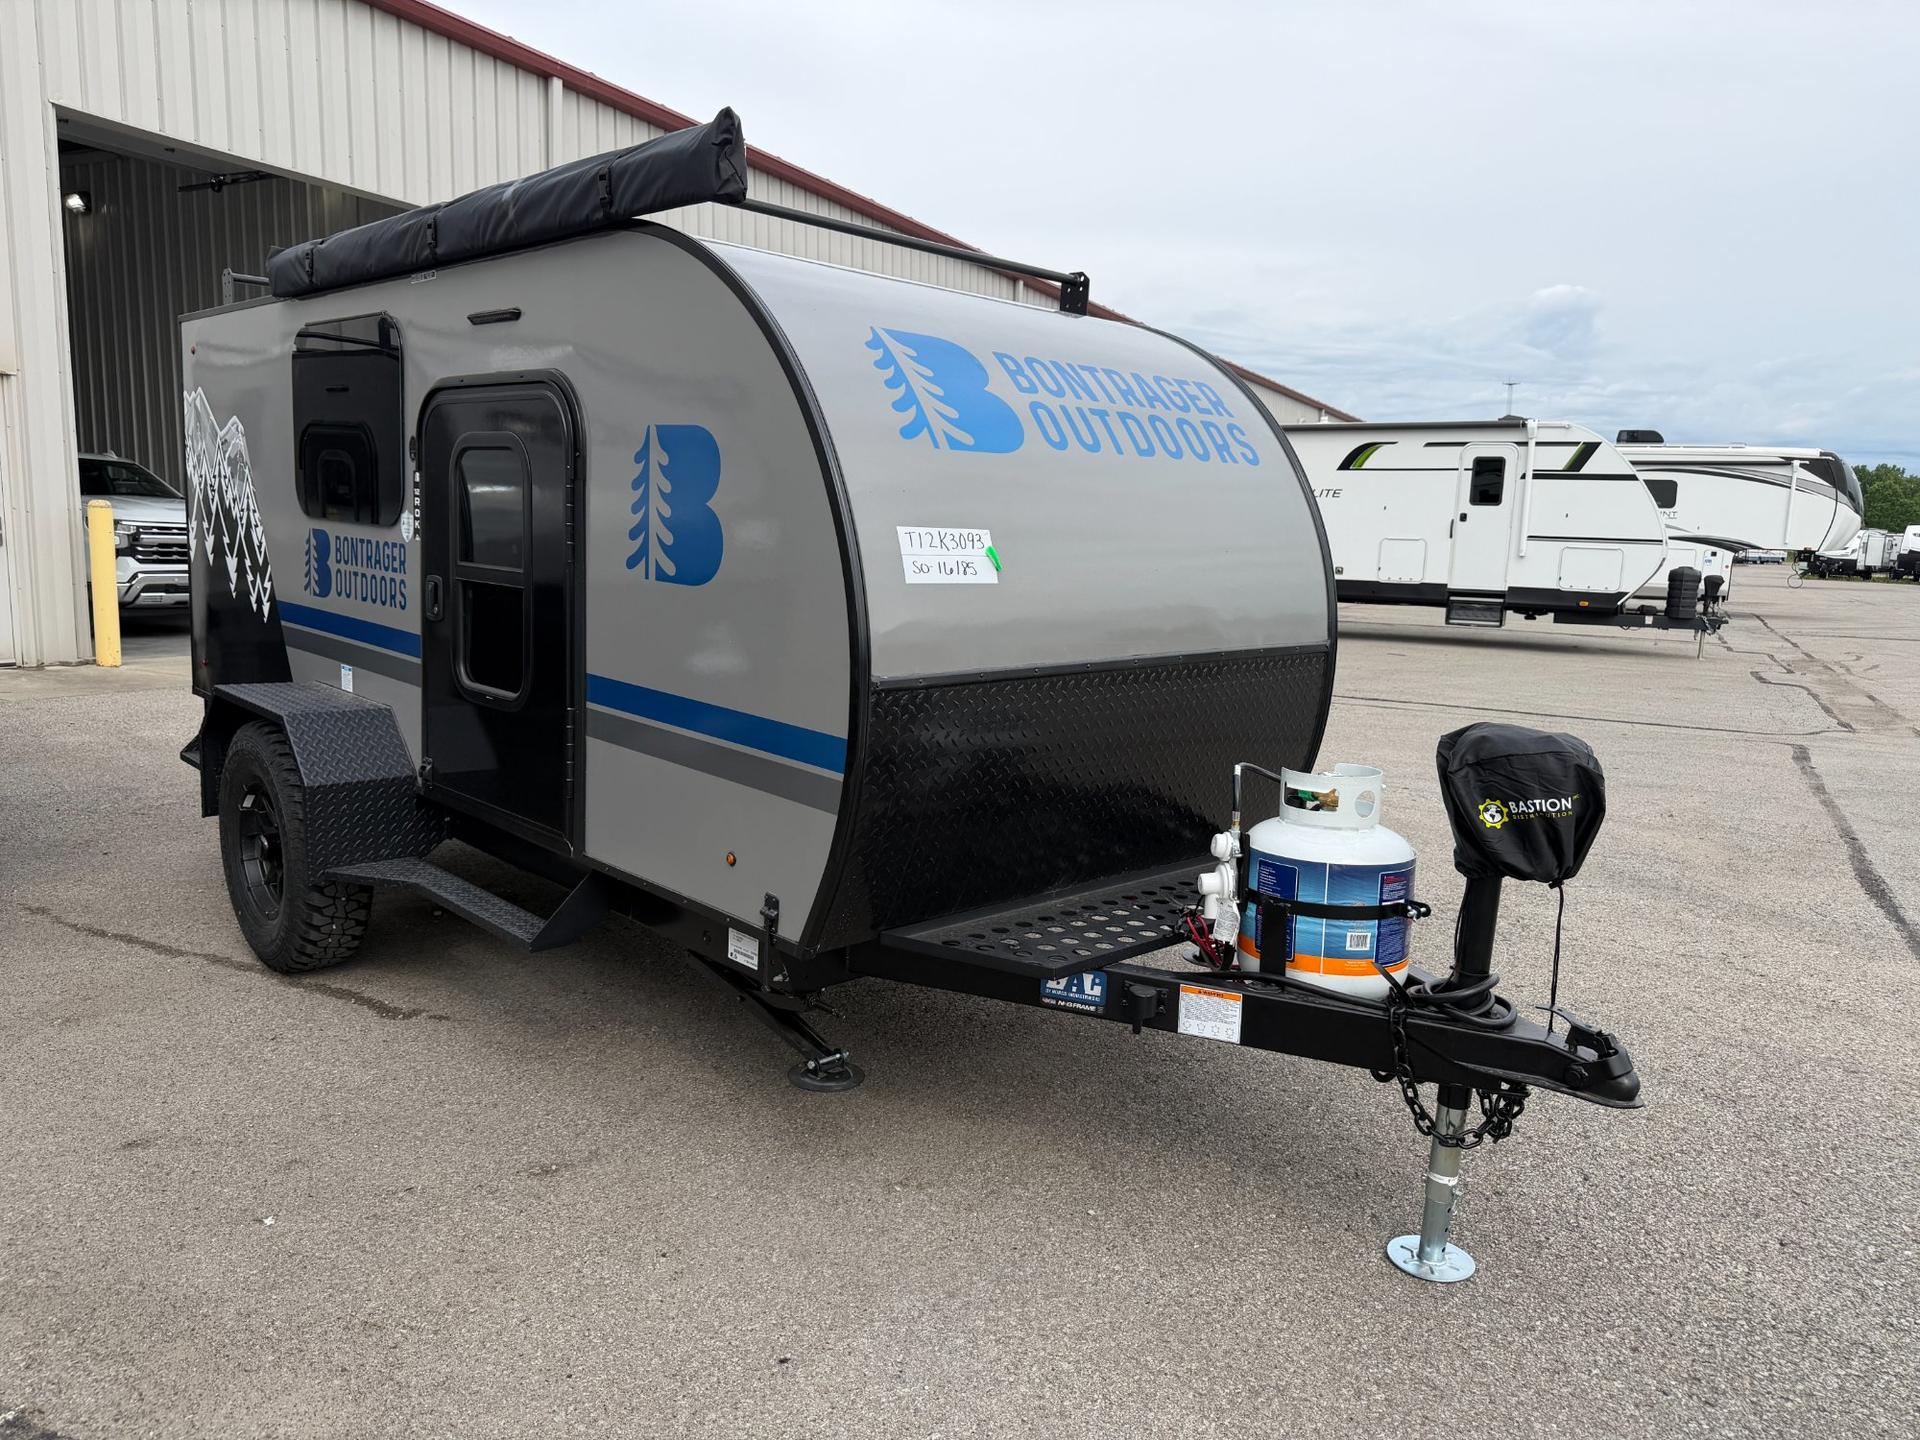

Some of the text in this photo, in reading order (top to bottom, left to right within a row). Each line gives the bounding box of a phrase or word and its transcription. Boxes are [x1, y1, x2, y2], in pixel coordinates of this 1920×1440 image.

[992, 351, 1234, 418] BONTRAGER
[1028, 401, 1260, 466] OUTDOORS
[335, 535, 407, 575] BONTRAGER
[904, 530, 985, 552] T12K3093
[335, 568, 407, 611] OUTDOORS
[1508, 797, 1572, 813] BASTION
[1512, 811, 1573, 820] DISTRIUTION
